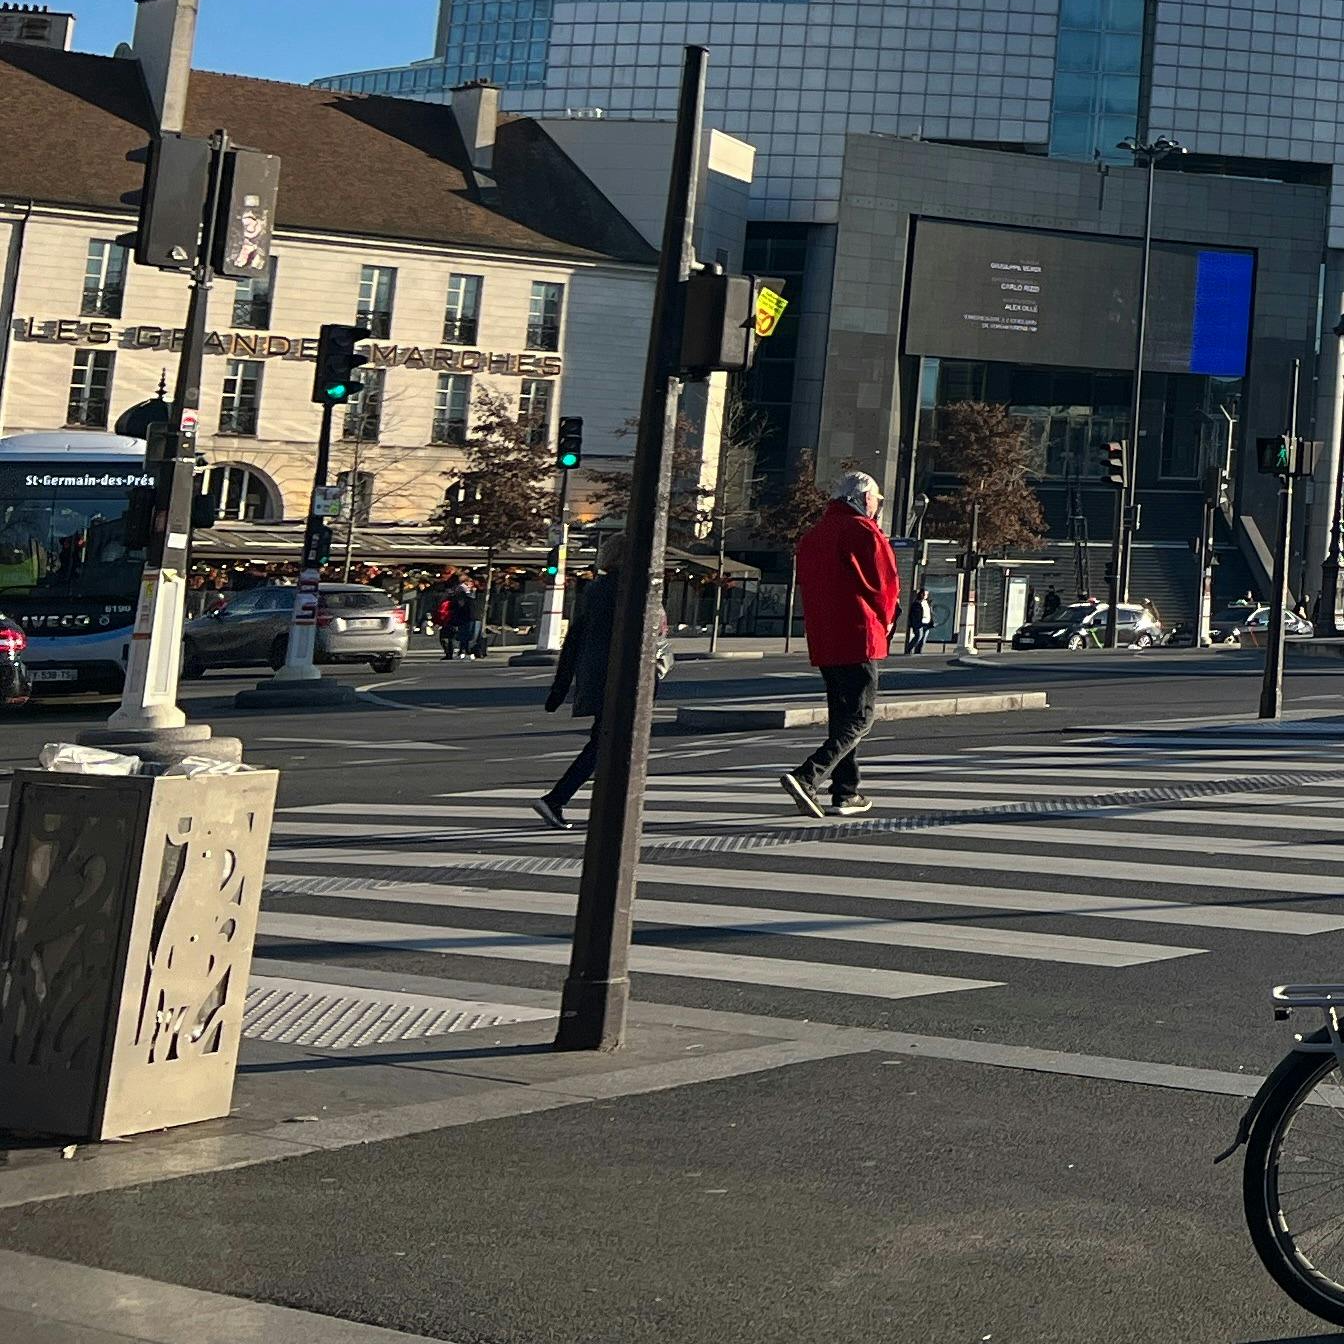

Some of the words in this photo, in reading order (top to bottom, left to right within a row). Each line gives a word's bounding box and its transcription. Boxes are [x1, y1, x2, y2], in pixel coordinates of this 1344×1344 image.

[26, 316, 112, 344] LES
[135, 325, 319, 357] GRANDE
[371, 342, 562, 376] MARCHES
[22, 615, 90, 628] IVECO
